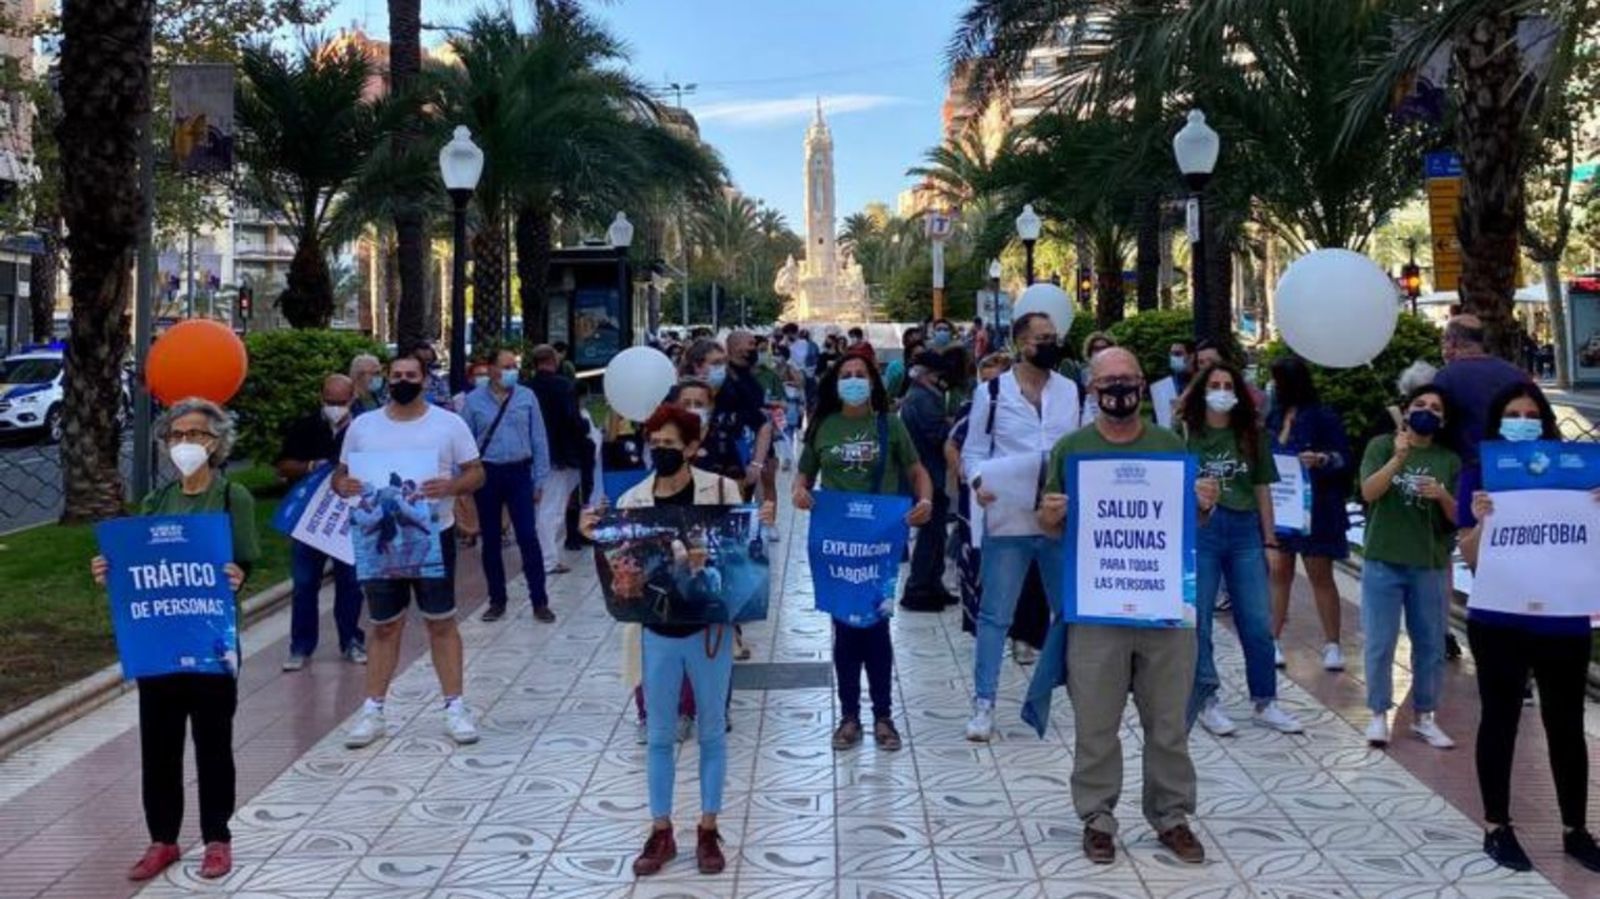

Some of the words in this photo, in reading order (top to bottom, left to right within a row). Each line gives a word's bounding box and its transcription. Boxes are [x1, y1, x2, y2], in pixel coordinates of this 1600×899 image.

[1097, 499, 1149, 519] SALUD
[1152, 500, 1164, 520] Y
[1093, 529, 1166, 550] VACUNAS
[1491, 523, 1588, 547] LGTBIQFOBIA
[128, 558, 216, 590] TRÁFICO
[828, 563, 880, 584] LABORAL
[1100, 558, 1126, 571] PARA
[1128, 559, 1159, 572] TODAS
[1094, 577, 1114, 590] LAS
[1115, 577, 1166, 591] PERSONAS
[130, 601, 151, 620] DE
[153, 598, 224, 617] PERSONAS
